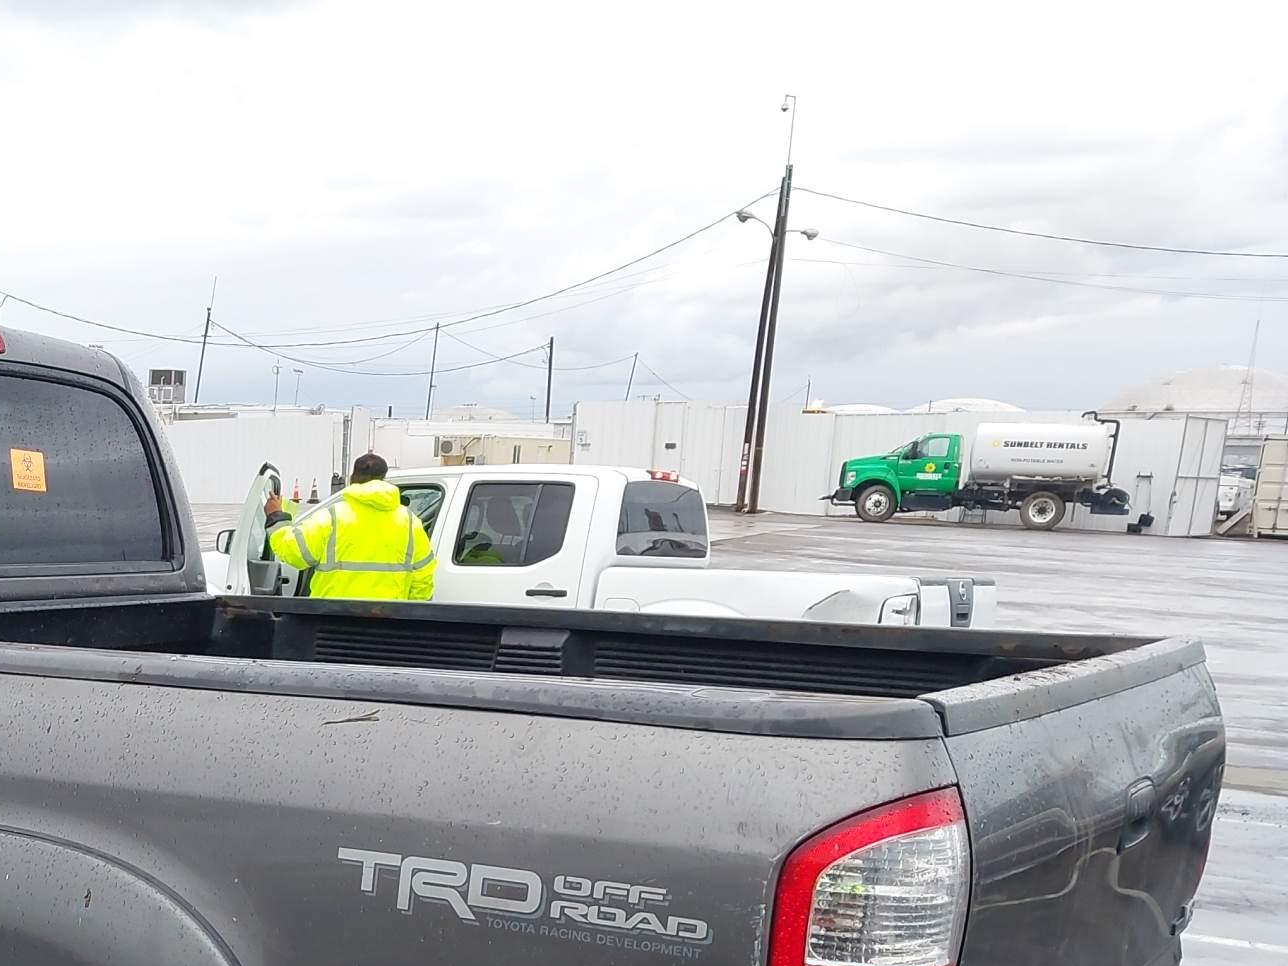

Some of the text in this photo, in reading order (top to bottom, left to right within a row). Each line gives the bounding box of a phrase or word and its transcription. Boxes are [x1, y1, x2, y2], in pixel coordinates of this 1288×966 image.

[1002, 440, 1089, 450] SUNBELT RENTALS
[337, 846, 546, 923] TRD
[552, 874, 670, 906] OFF
[486, 917, 703, 961] TOYOTA RACING DEVELOPMENT
[549, 899, 712, 941] ROAD
